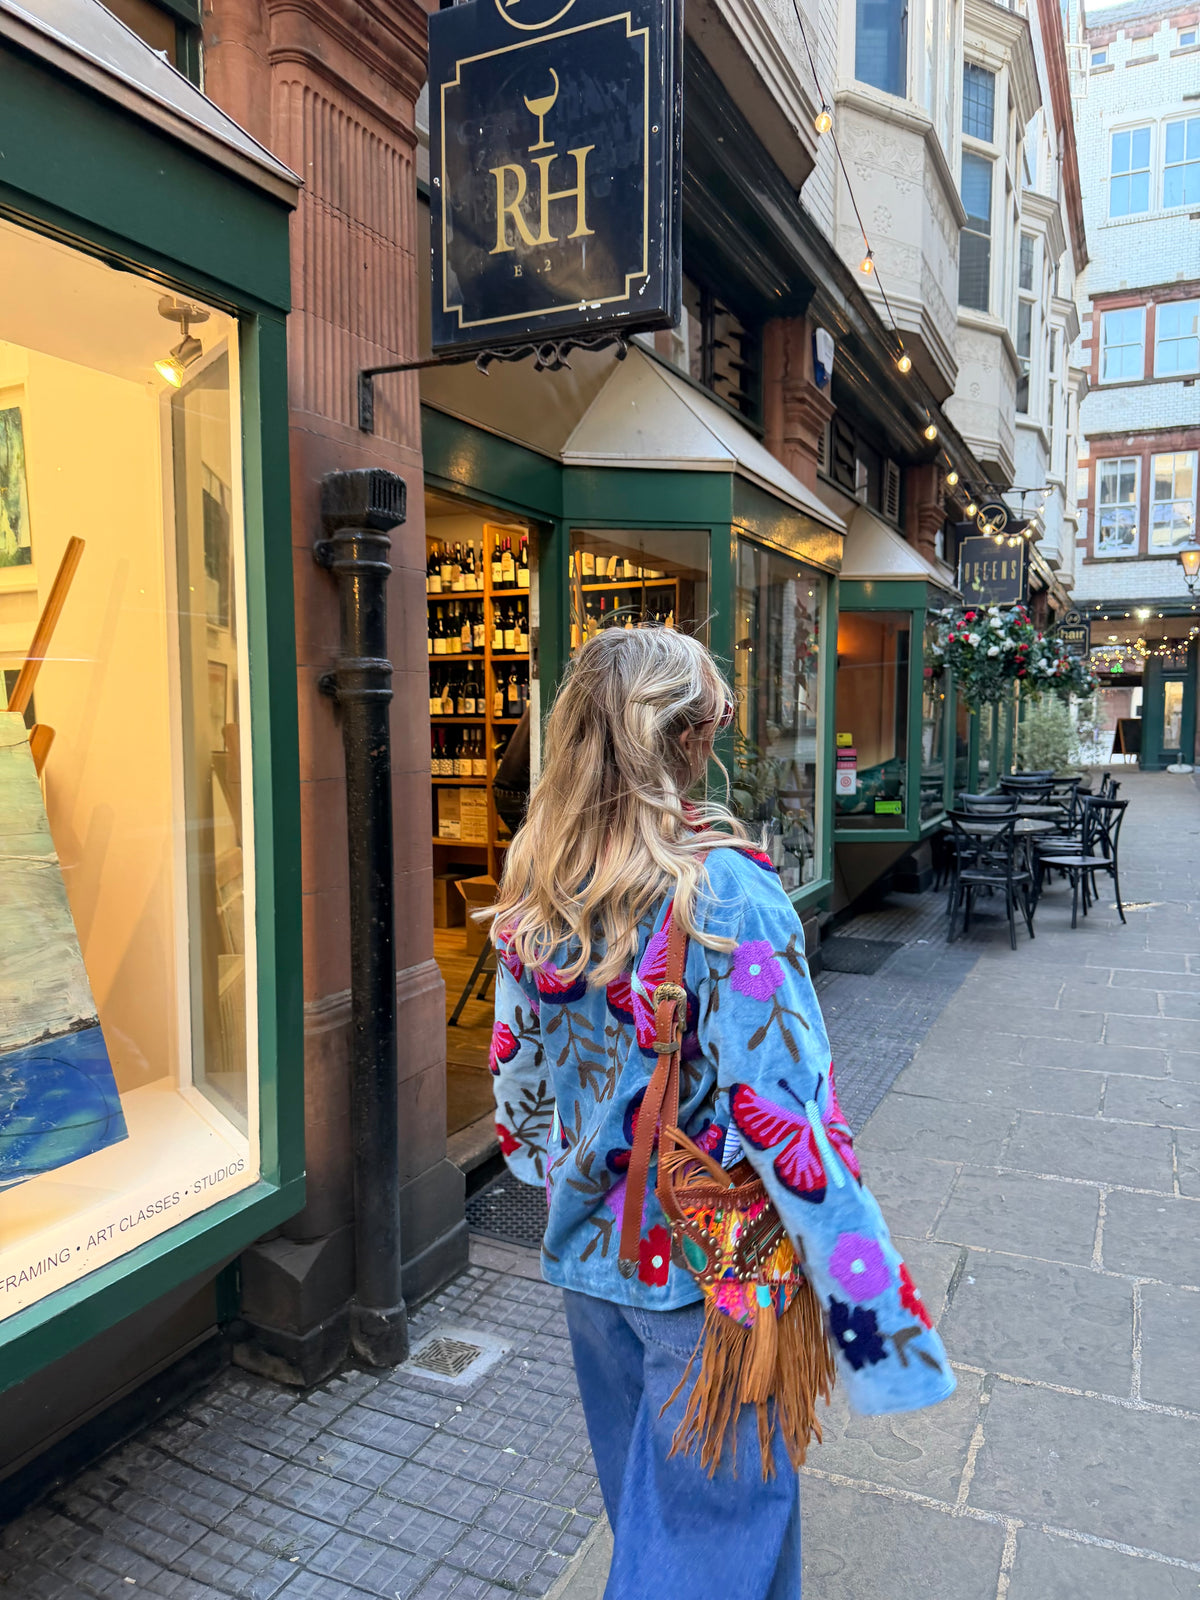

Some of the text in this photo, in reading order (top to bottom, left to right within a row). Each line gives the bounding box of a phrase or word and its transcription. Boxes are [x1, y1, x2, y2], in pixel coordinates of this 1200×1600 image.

[489, 145, 595, 255] RH
[964, 560, 1017, 583] QUEENS
[1060, 629, 1085, 640] hair
[87, 1224, 115, 1250] ART
[119, 1191, 180, 1232] CLASSES
[193, 1159, 245, 1194] STUDIOS
